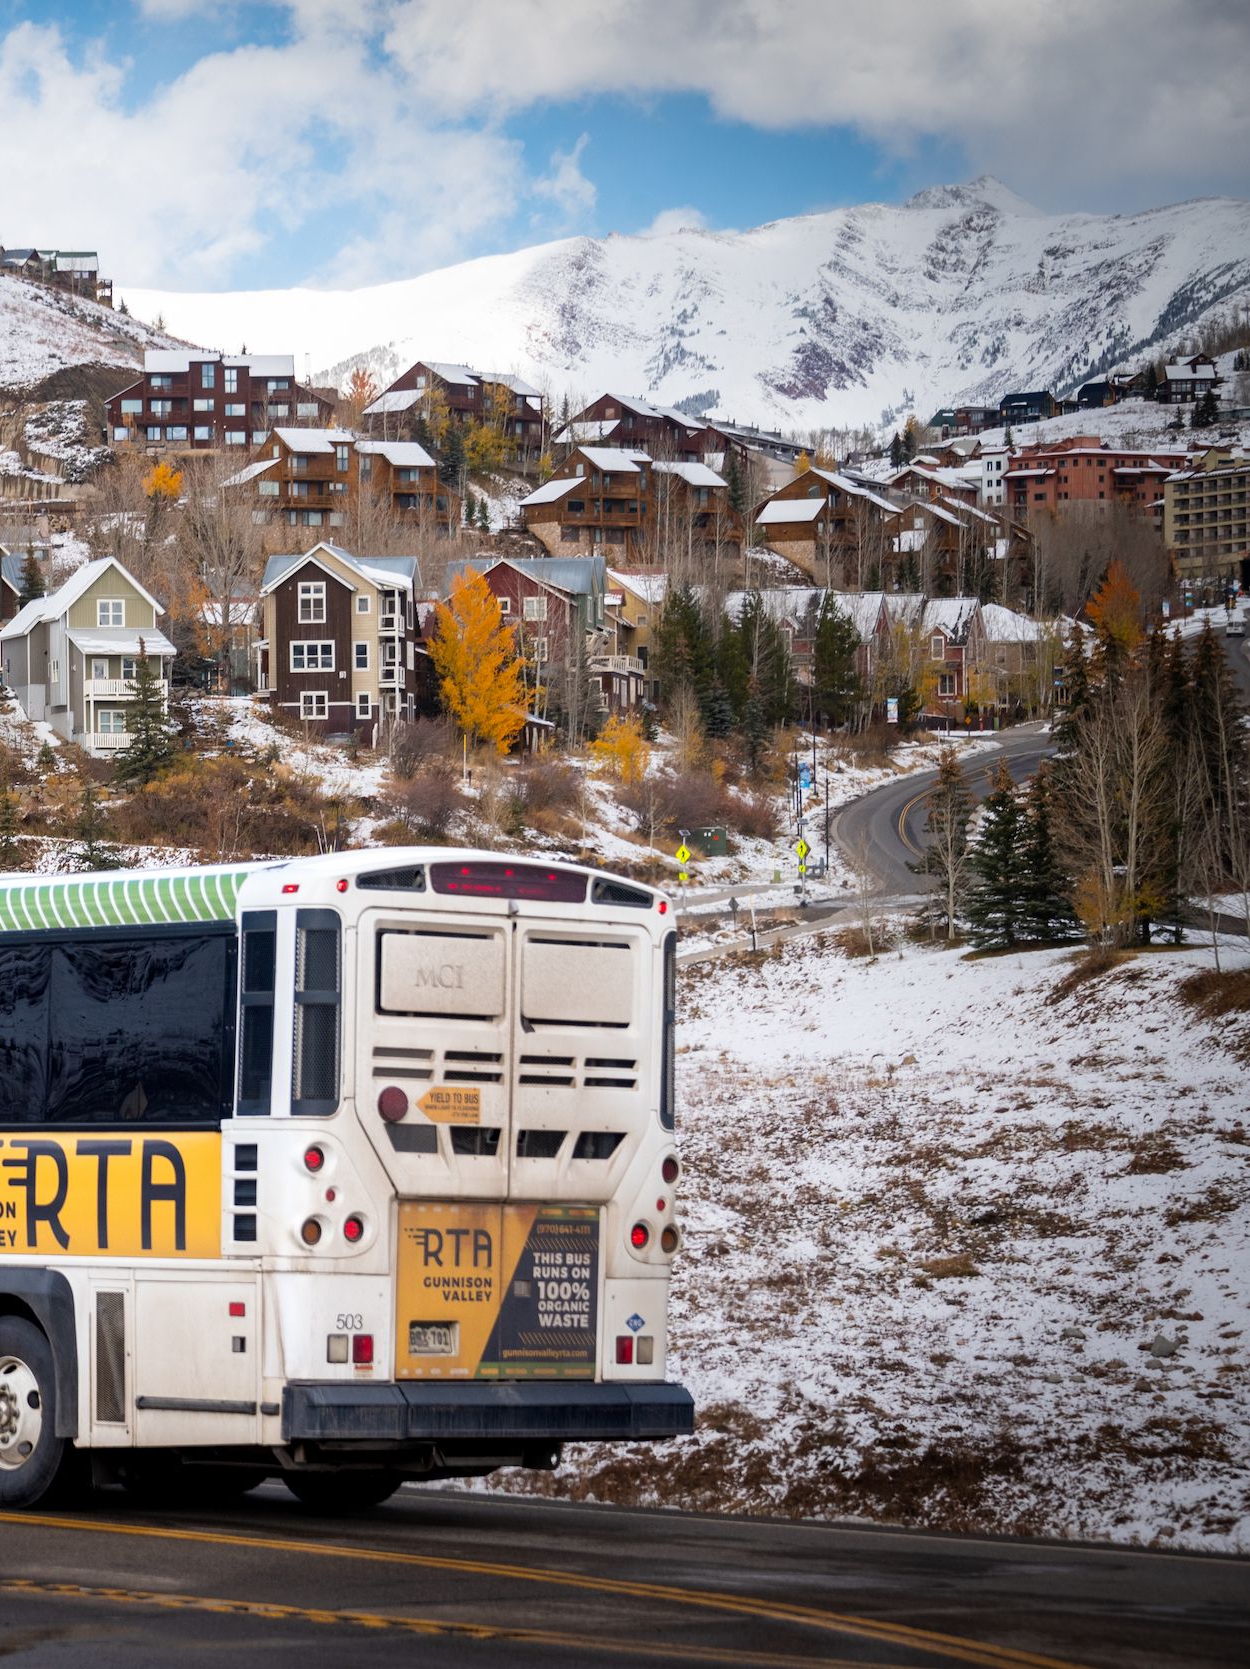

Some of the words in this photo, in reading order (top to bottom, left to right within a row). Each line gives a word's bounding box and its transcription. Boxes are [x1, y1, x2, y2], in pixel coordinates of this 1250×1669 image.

[413, 964, 463, 989] MCI
[430, 1092, 450, 1103] YIELD
[453, 1093, 462, 1103] TO
[464, 1094, 479, 1104] BUS
[2, 1139, 186, 1250] RTA
[415, 1228, 492, 1267] RTA
[533, 1252, 563, 1264] THIS
[566, 1253, 591, 1265] BUS
[533, 1266, 568, 1279] RUNS
[571, 1267, 590, 1279] ON
[423, 1277, 492, 1288] GUNNISON
[442, 1290, 492, 1302] VALLEY
[537, 1281, 590, 1300] 100%
[538, 1301, 590, 1312] ORGANIC
[336, 1313, 363, 1330] 503
[538, 1314, 589, 1328] WASTE
[502, 1347, 588, 1358] gunnisonvalleyrta.com
